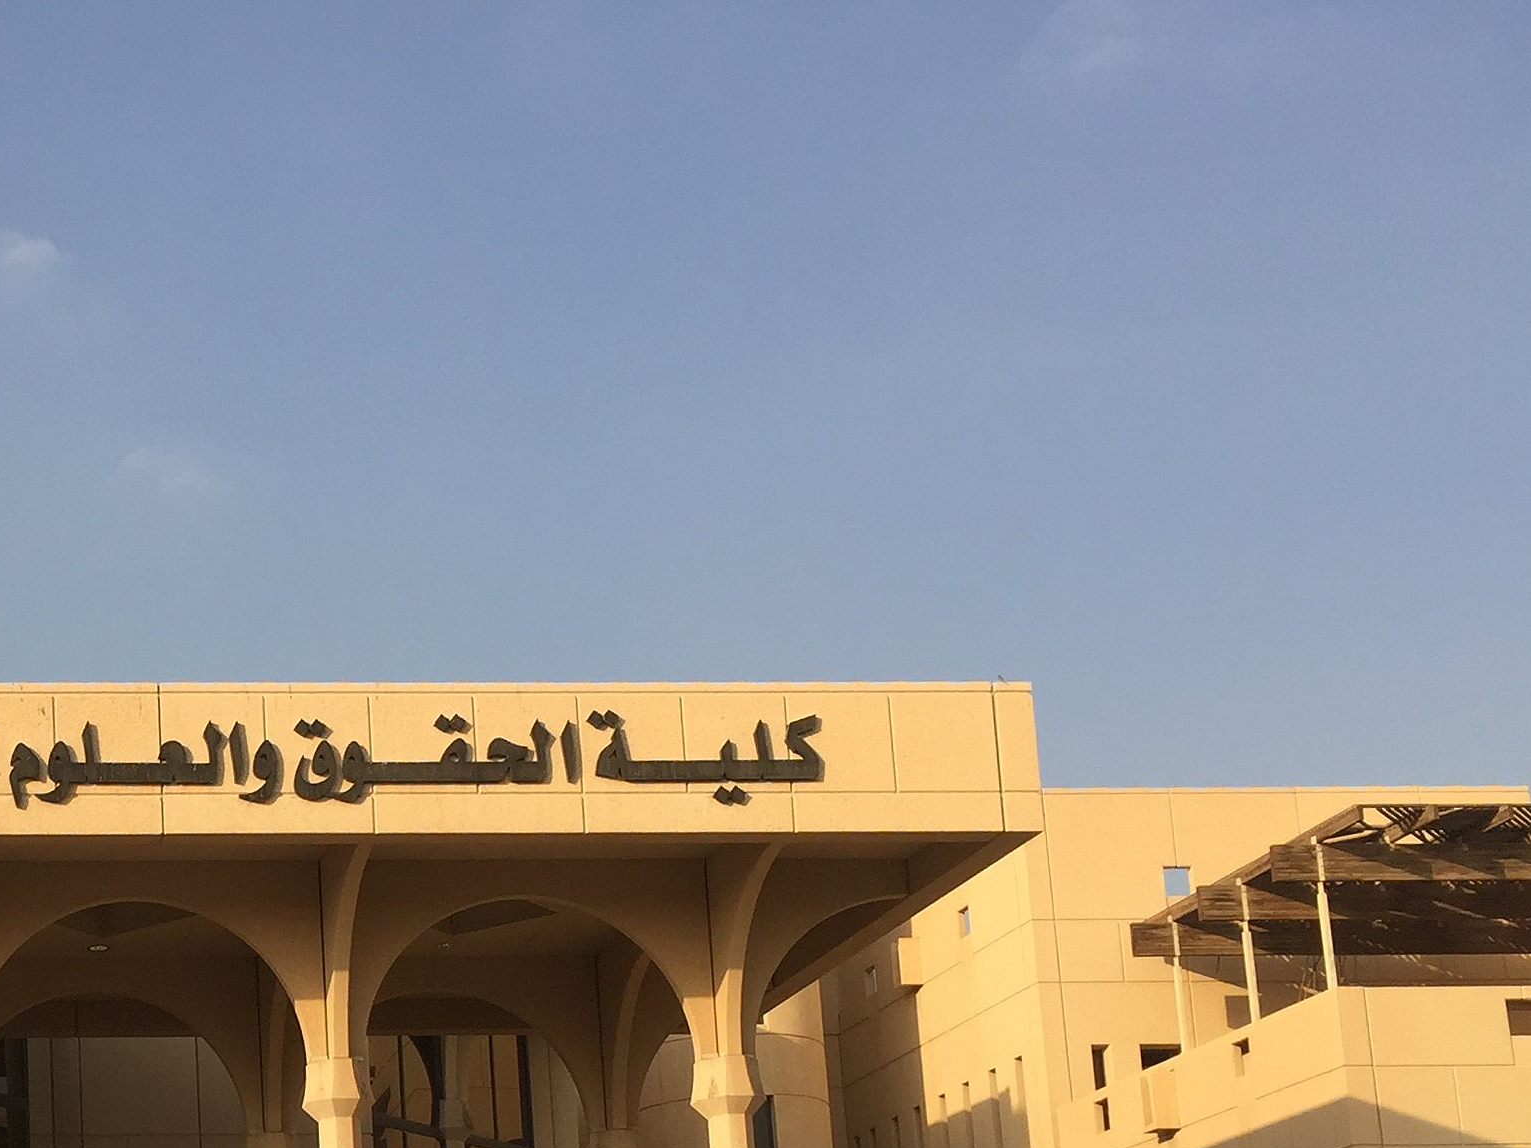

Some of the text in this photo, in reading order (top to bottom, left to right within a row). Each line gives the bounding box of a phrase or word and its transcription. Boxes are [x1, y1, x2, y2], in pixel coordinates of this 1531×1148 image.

[10, 719, 284, 812] والعلوم
[293, 713, 582, 804] الحقوق
[587, 709, 826, 807] كلية
